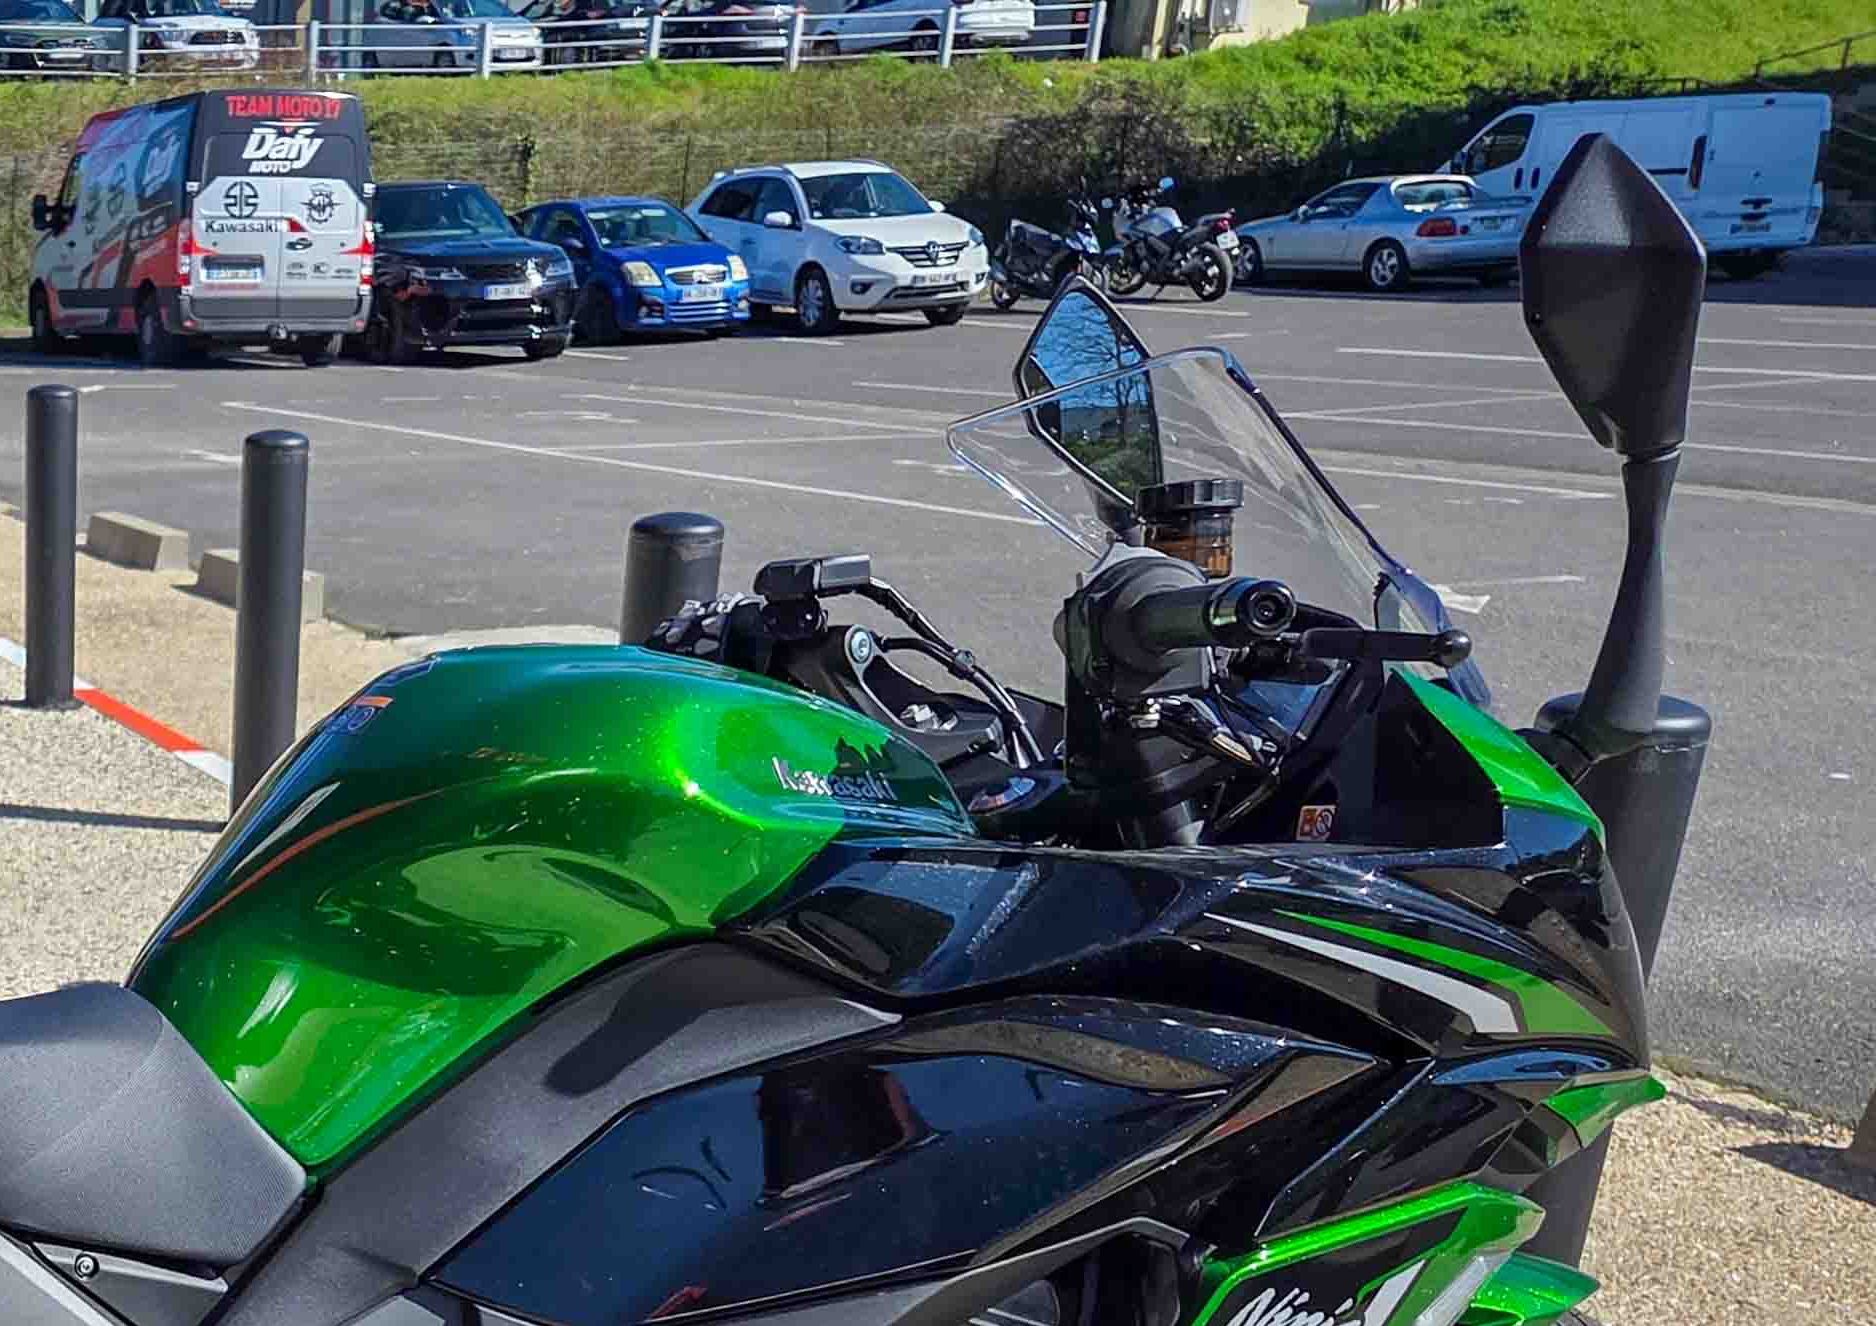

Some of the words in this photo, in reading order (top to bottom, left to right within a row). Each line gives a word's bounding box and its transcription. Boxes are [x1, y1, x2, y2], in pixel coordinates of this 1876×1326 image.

[226, 95, 273, 117] TEAM
[275, 95, 322, 118] MOTO
[241, 127, 324, 169] Dafy
[248, 160, 293, 174] MOTO
[204, 220, 279, 233] Kawasaki
[772, 756, 898, 800] Kawasaki
